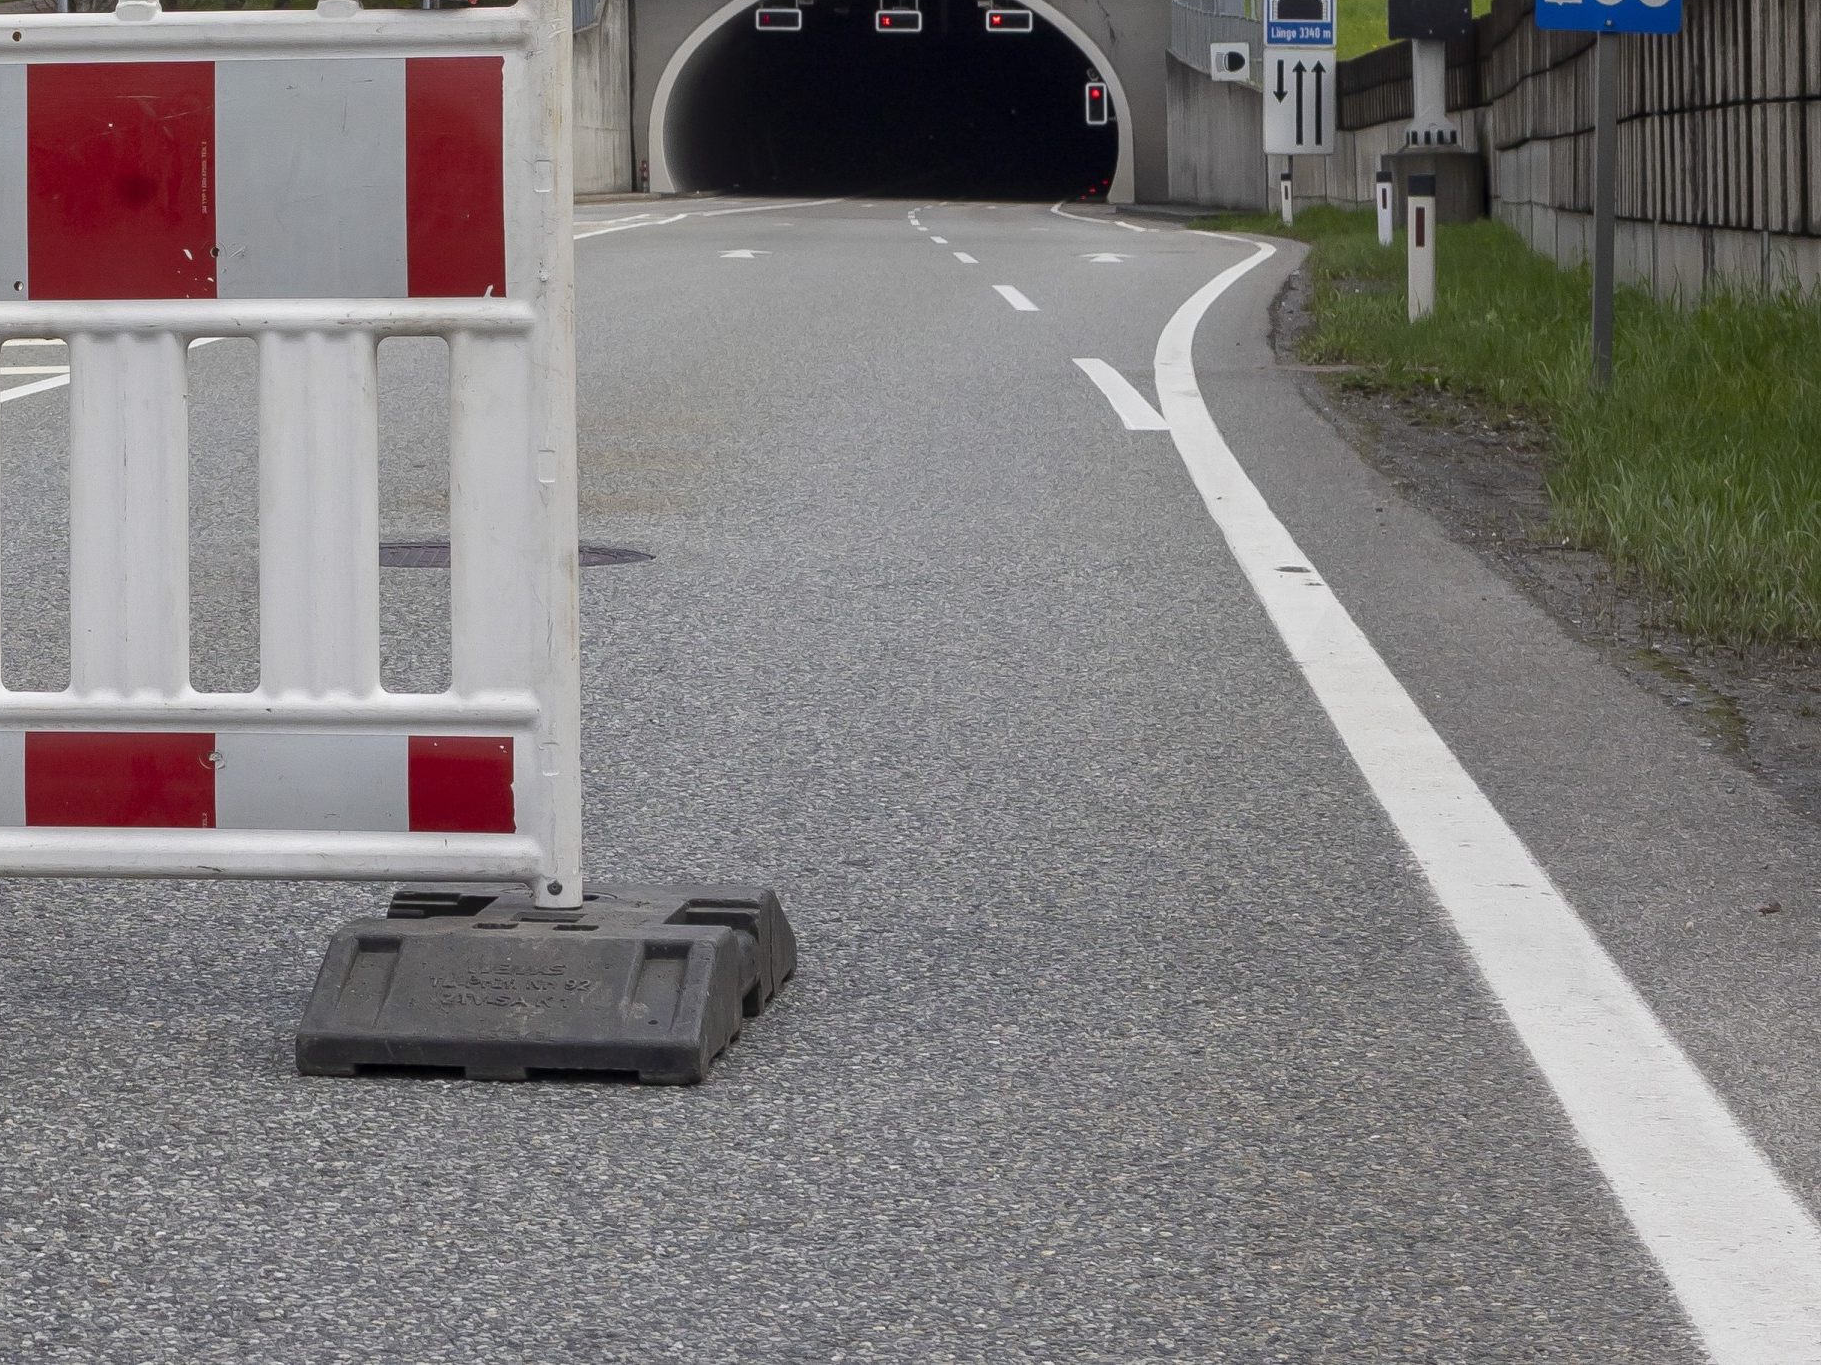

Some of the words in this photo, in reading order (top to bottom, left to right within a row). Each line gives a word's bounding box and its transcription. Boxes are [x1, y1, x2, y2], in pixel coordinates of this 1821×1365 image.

[1271, 26, 1297, 41] Länge
[1322, 29, 1331, 39] m
[564, 978, 592, 992] 92
